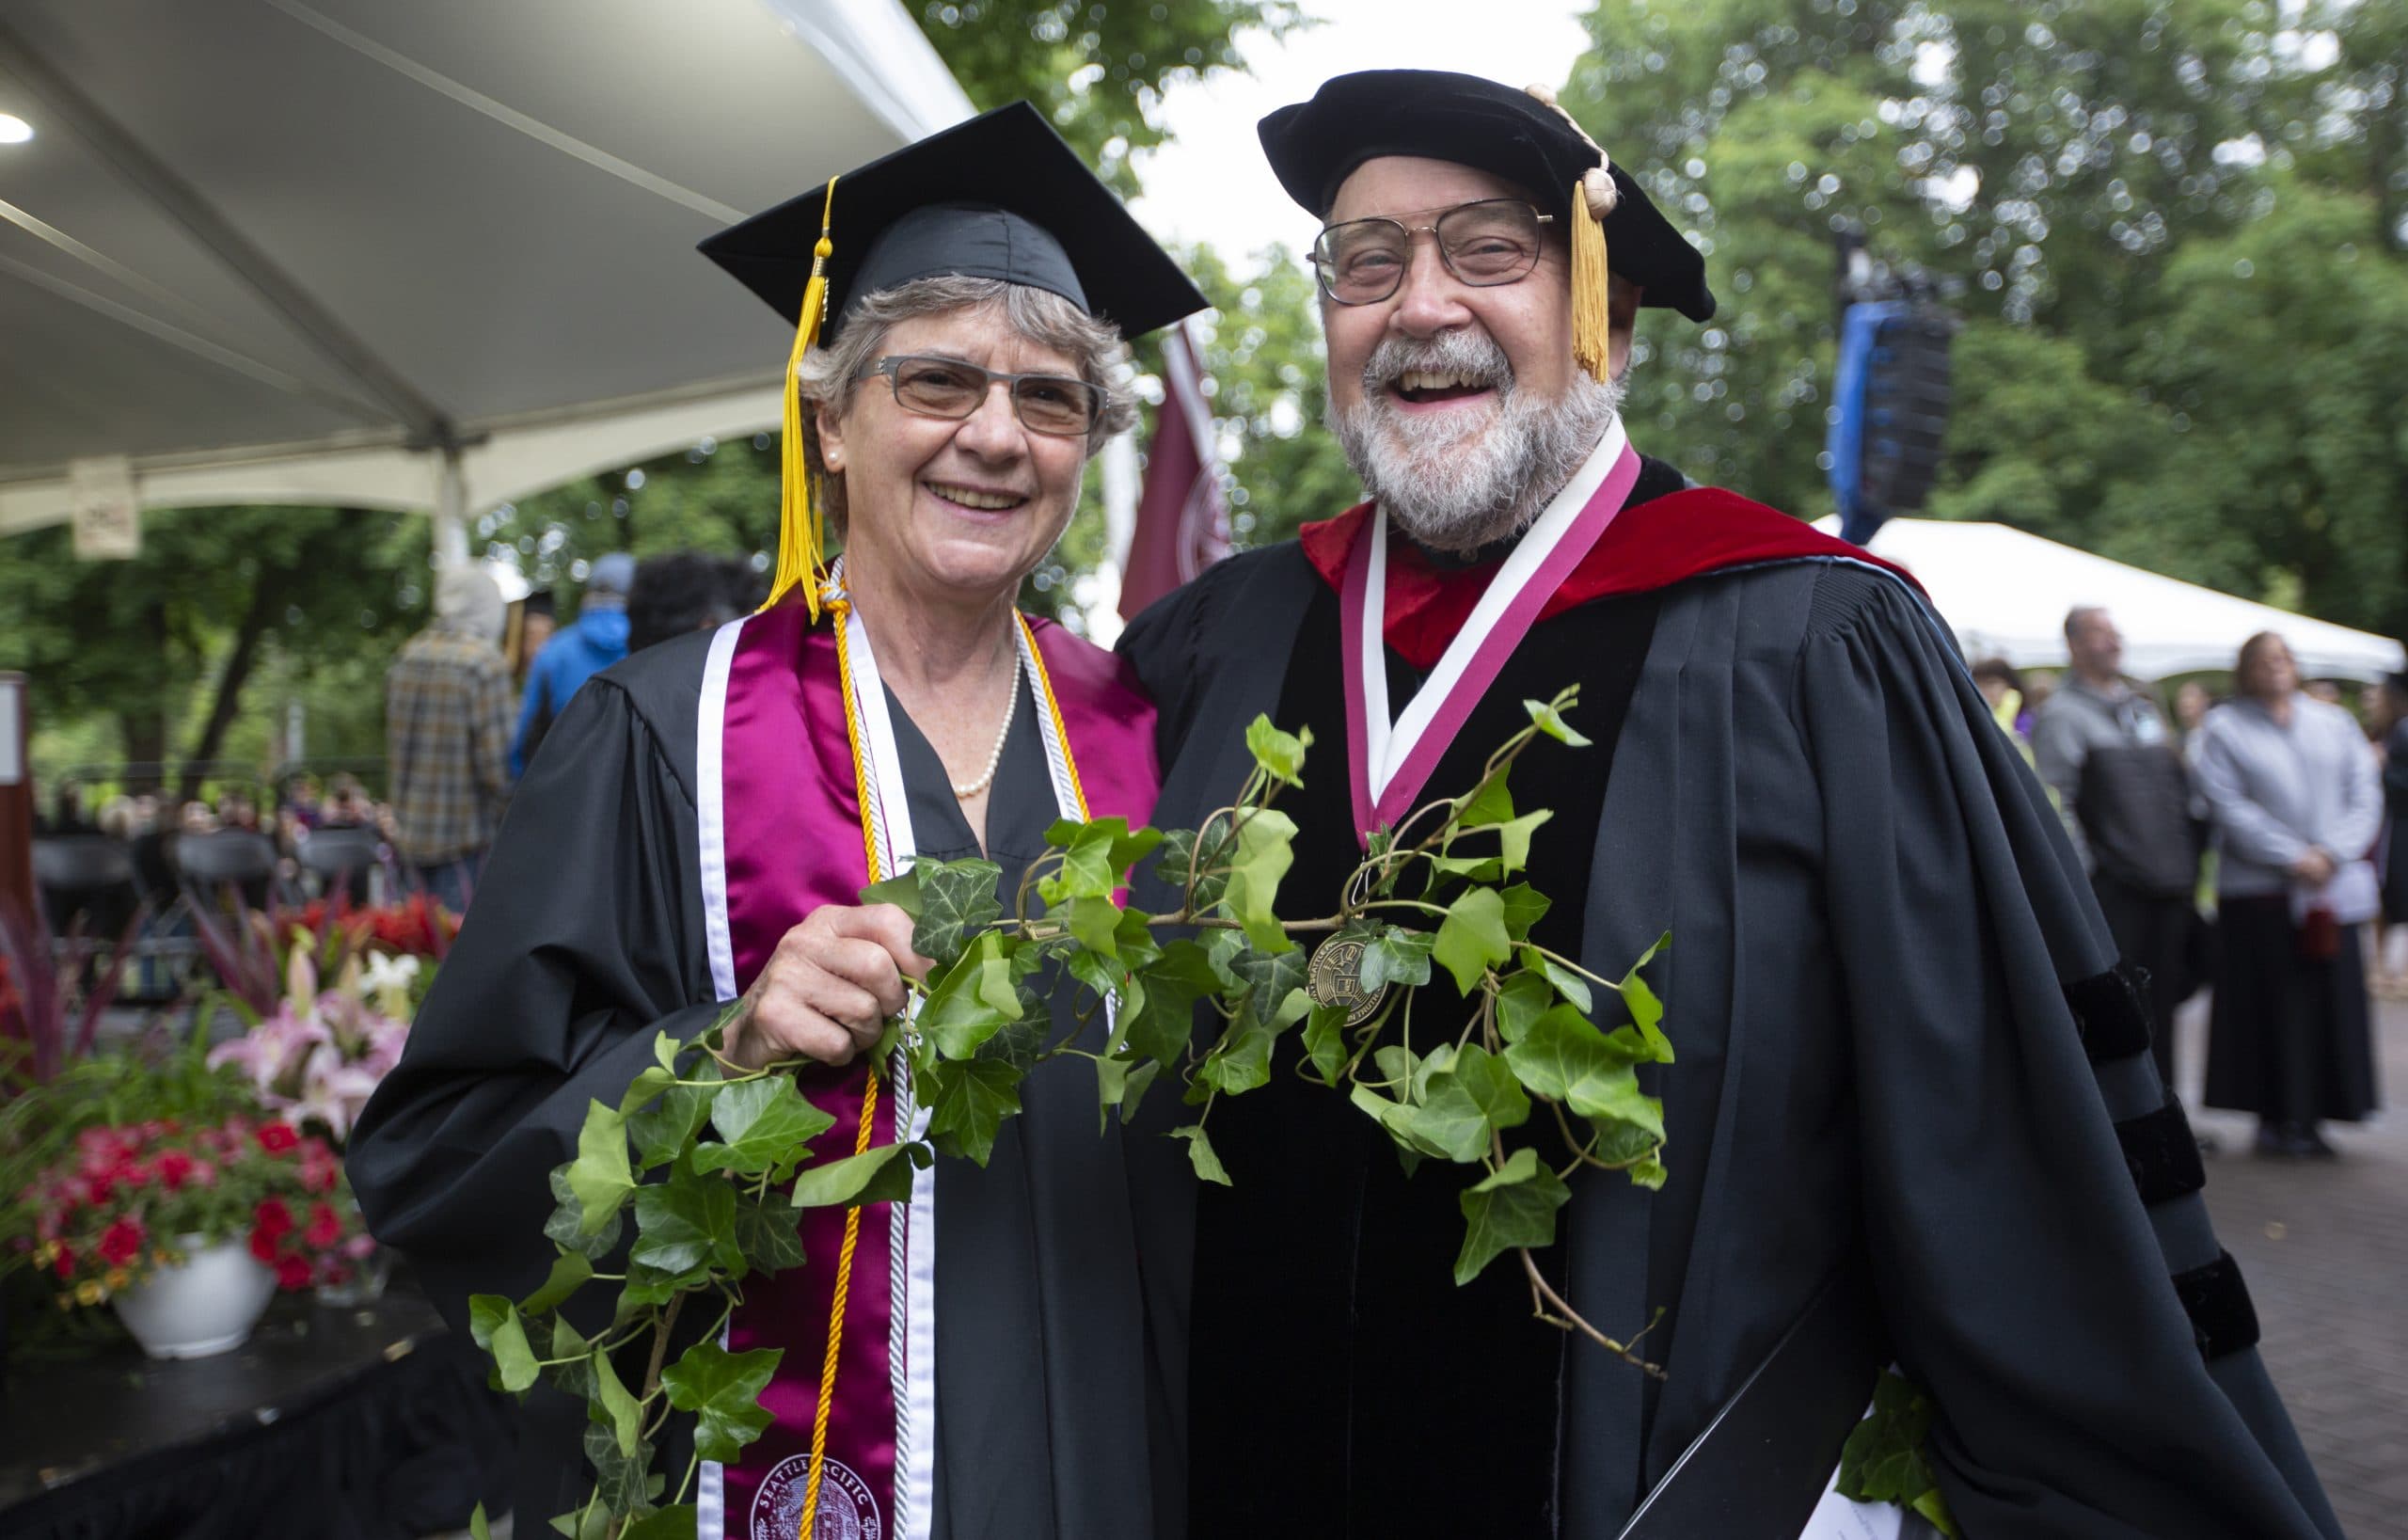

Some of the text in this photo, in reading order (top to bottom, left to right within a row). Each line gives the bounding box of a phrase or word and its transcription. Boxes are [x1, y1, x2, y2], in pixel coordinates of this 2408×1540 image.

[1356, 993, 1379, 1018] TRUTH
[759, 1459, 869, 1509] SEATTLE ACIFIC
